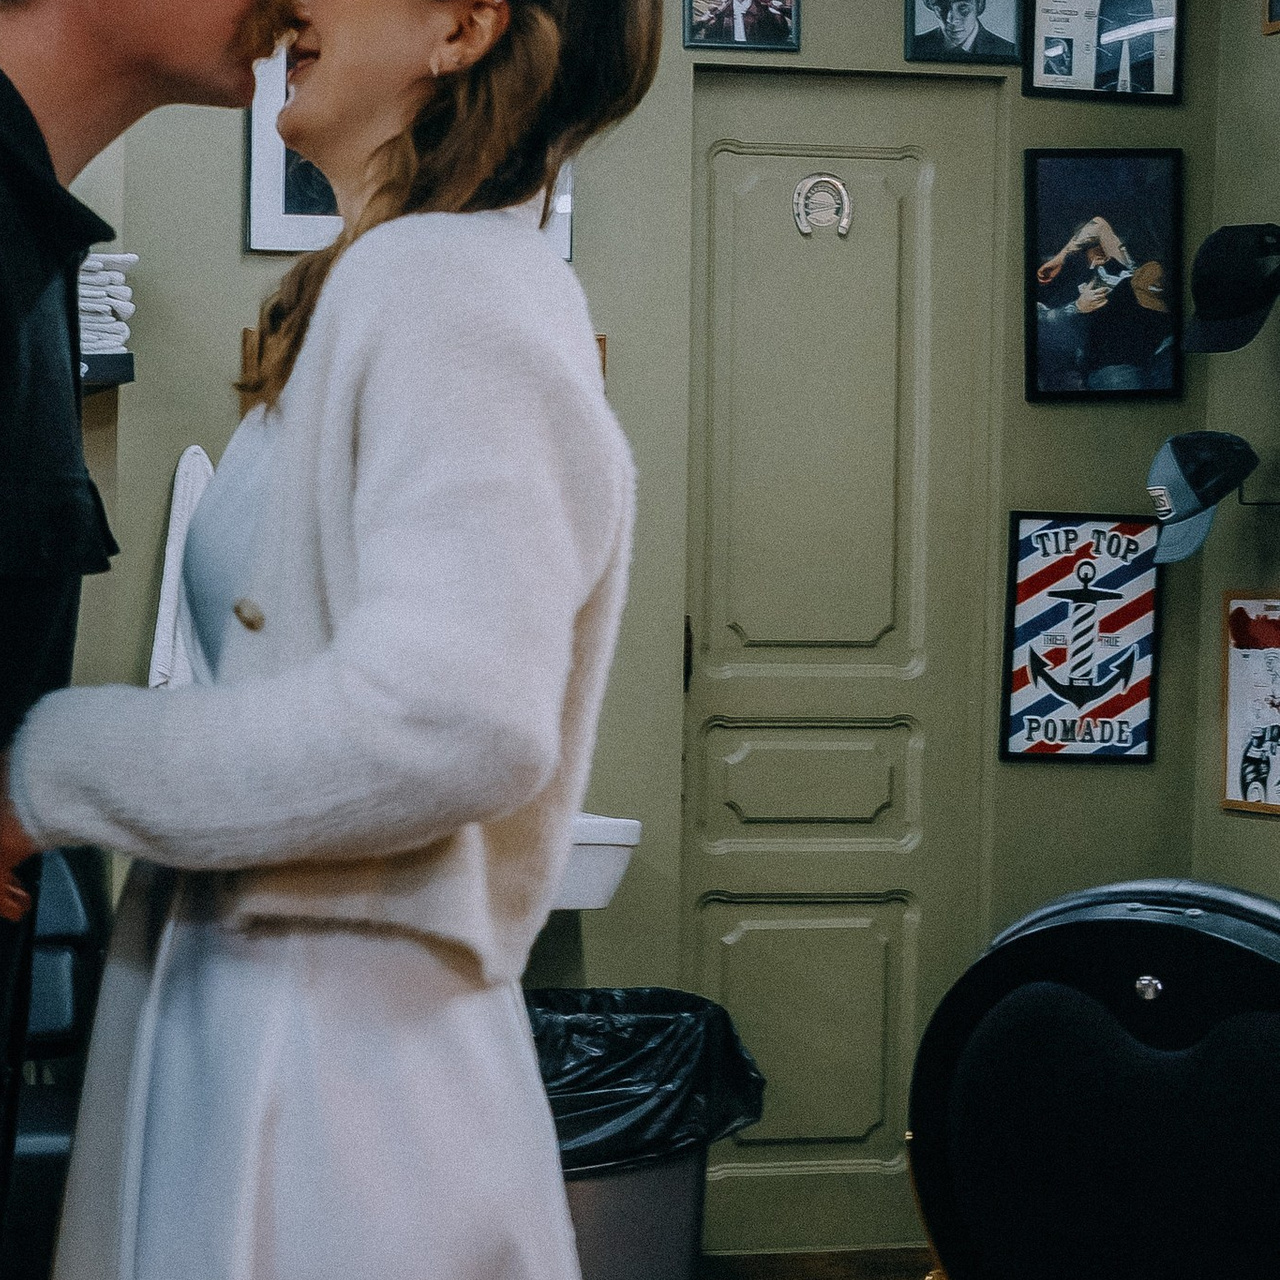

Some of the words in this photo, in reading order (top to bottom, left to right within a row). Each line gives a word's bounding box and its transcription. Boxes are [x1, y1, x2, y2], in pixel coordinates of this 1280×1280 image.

[1035, 528, 1079, 558] TIP
[1090, 528, 1140, 562] TOP
[1025, 717, 1131, 745] POMADE
